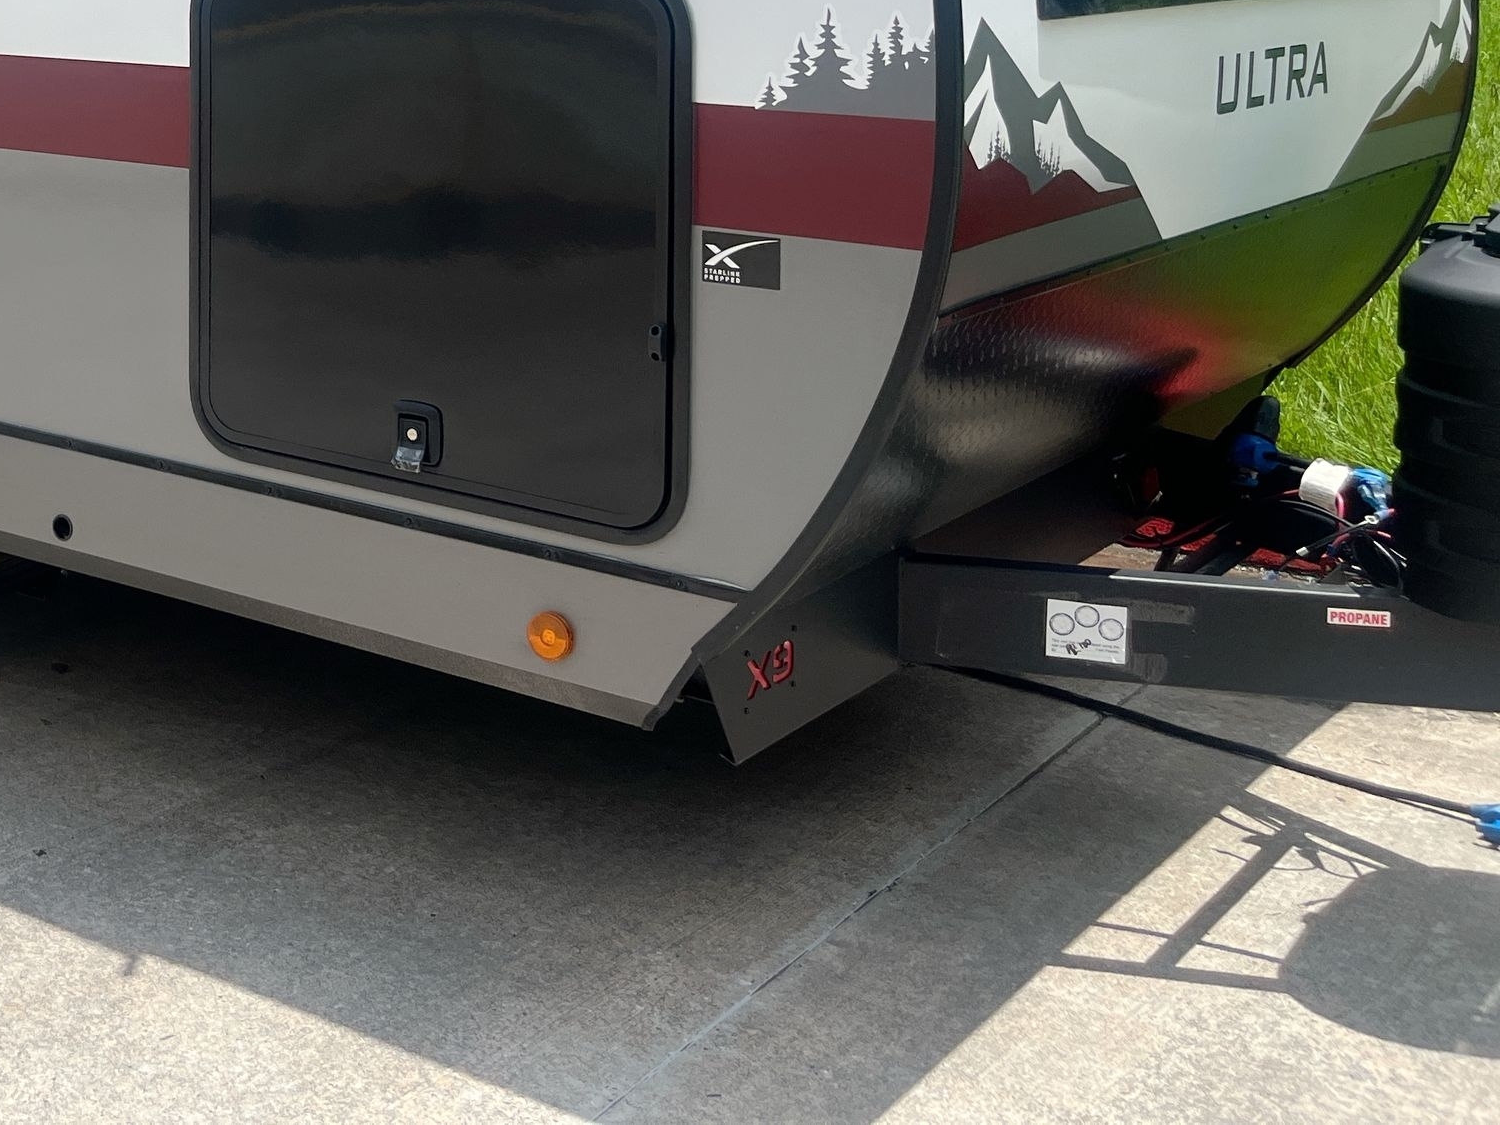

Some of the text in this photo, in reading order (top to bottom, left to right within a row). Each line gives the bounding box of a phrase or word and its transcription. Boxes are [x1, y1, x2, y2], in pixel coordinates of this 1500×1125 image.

[1217, 41, 1328, 115] ULTRA
[704, 268, 740, 277] STARLINK
[704, 275, 740, 283] PREPPED
[1330, 611, 1388, 625] PROPANE
[747, 639, 793, 700] X9
